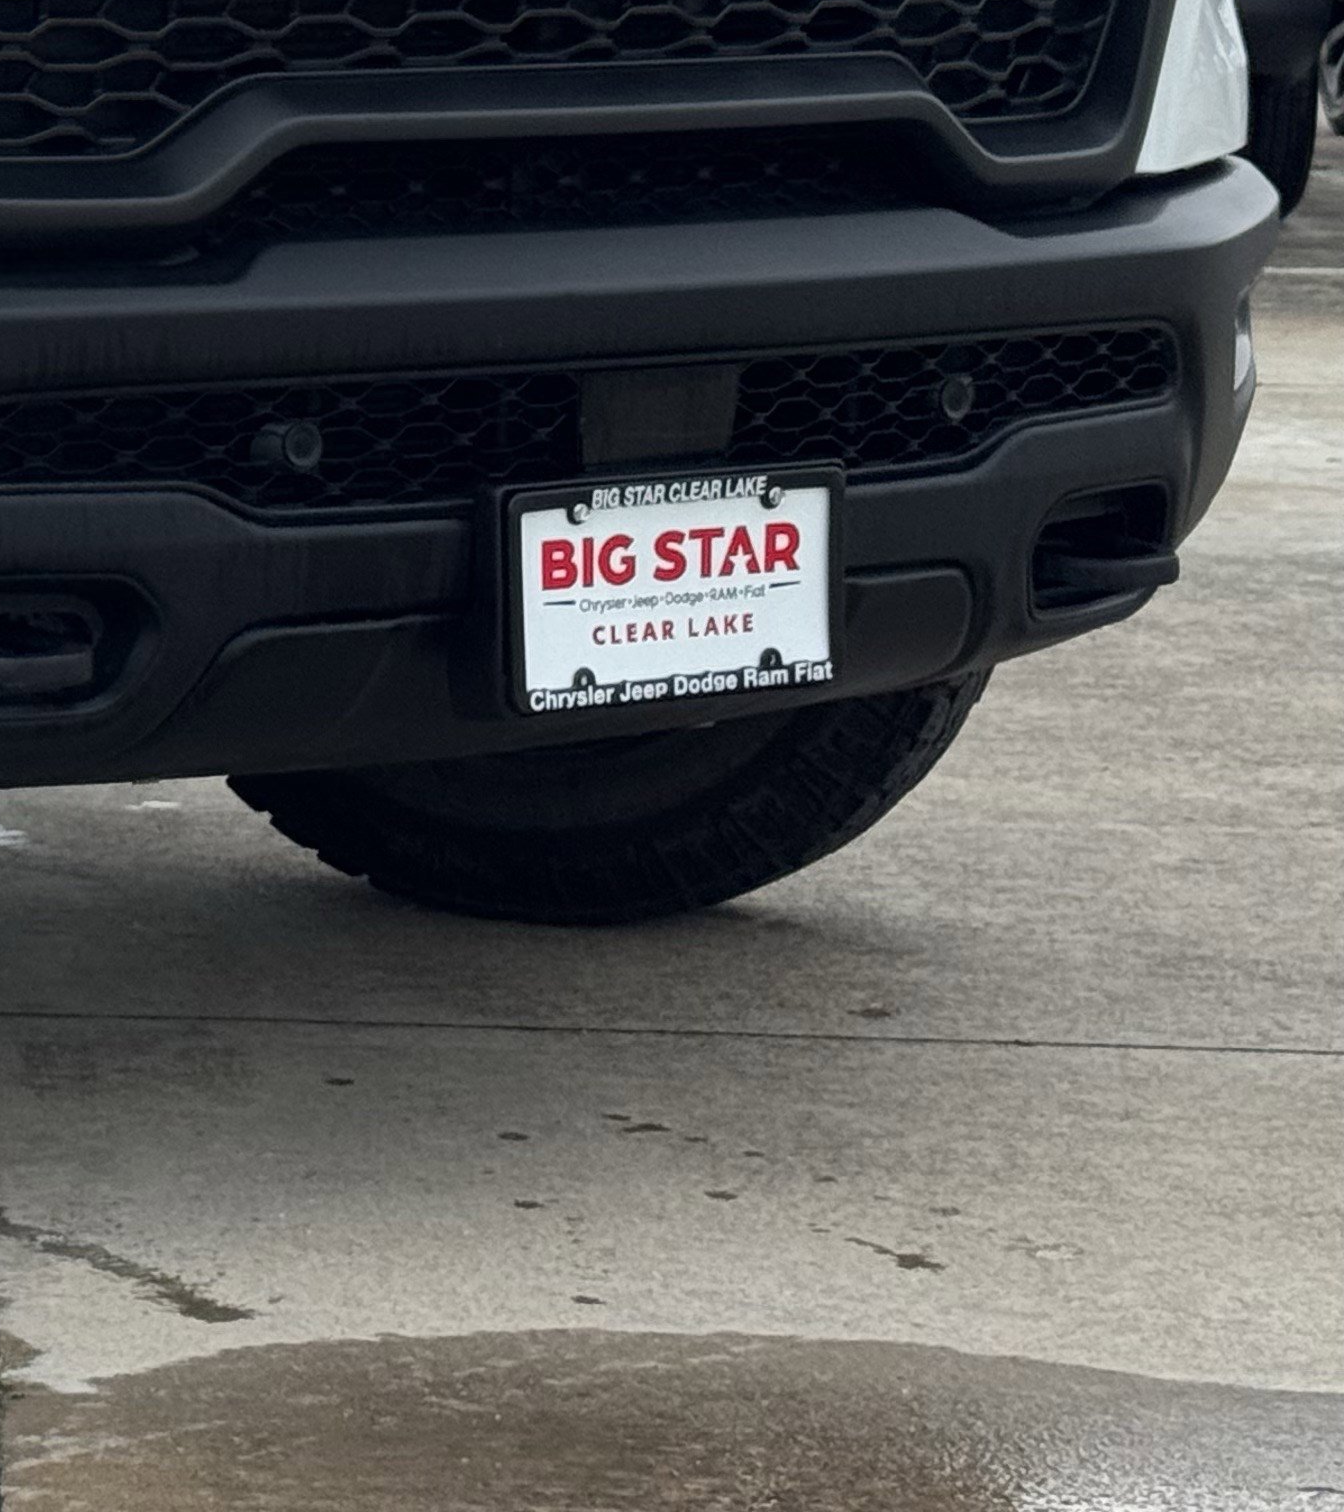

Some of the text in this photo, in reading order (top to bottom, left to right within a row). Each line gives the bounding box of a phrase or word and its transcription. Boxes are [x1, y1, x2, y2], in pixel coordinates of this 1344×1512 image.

[592, 475, 768, 510] BIG STAR CLEAR LAKE
[541, 521, 801, 591] BIG STAR
[592, 613, 755, 646] CLEAR LAKE
[529, 660, 834, 713] Chrysler Jeep Dodge Ram Fiat
